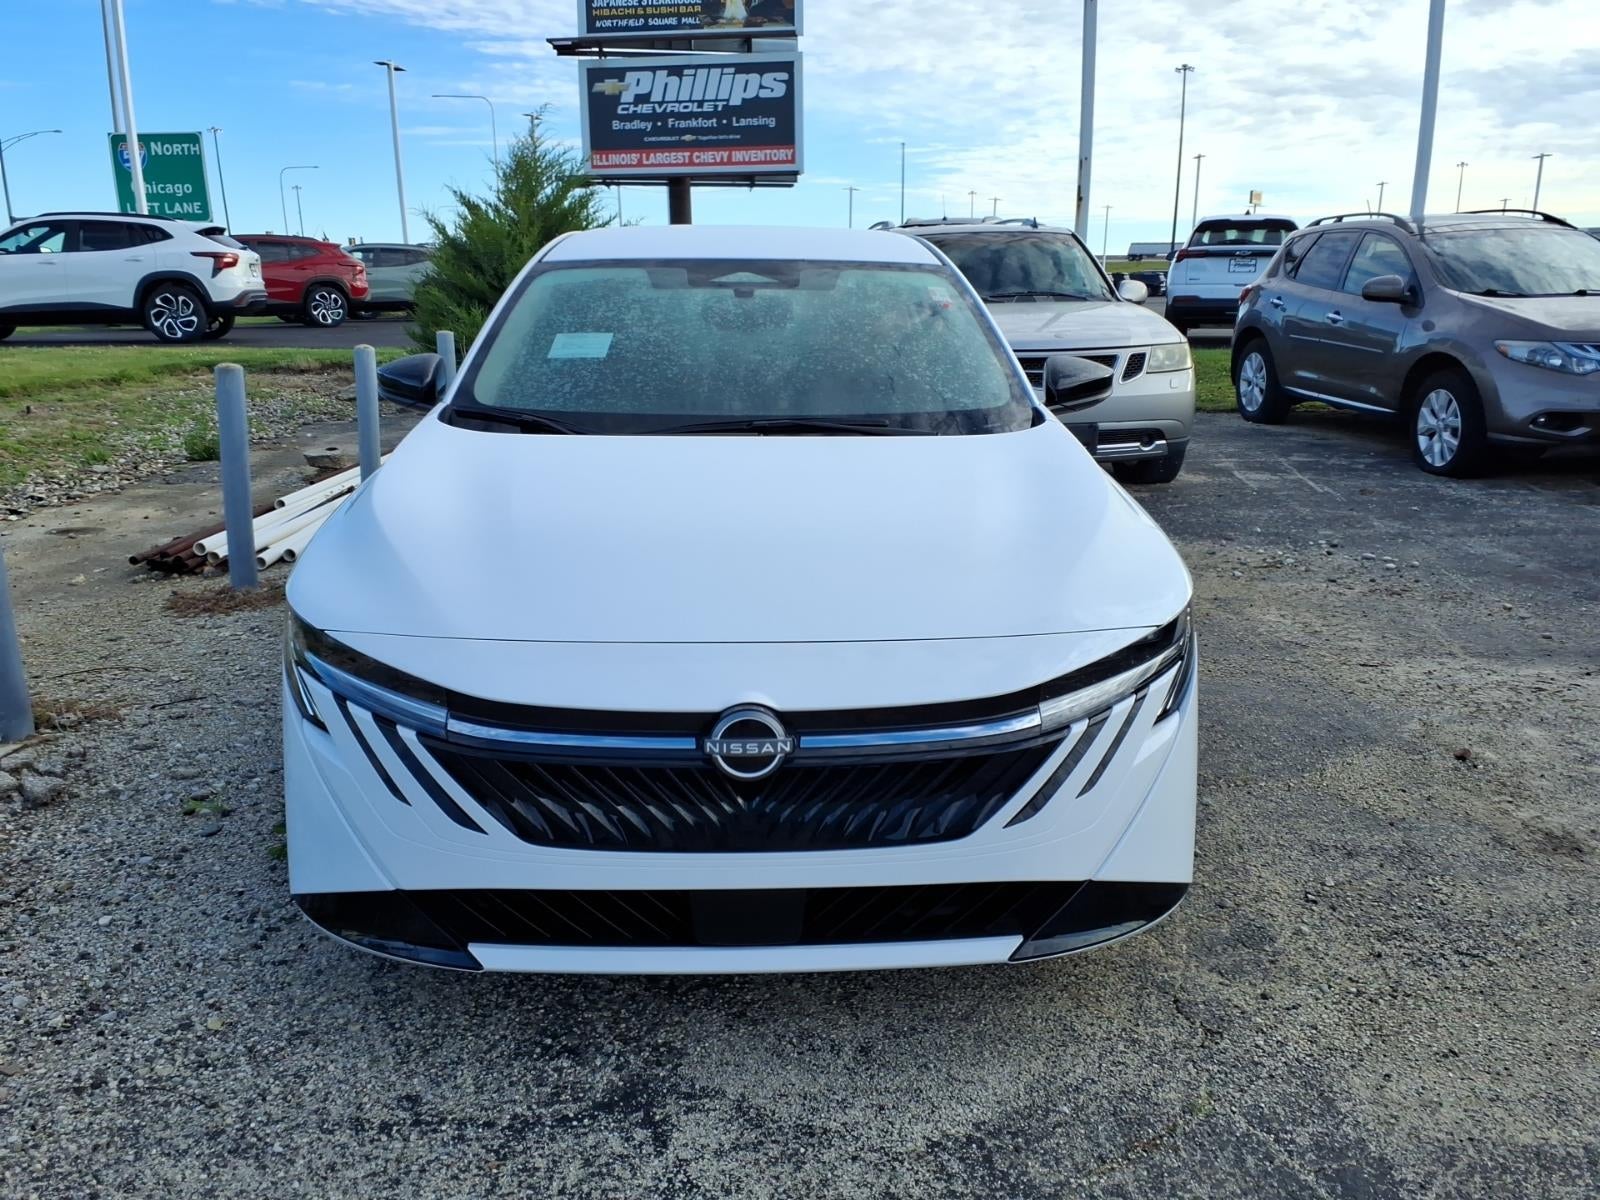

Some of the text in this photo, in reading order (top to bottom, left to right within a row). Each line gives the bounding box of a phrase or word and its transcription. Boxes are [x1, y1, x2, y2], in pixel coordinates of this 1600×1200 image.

[592, 8, 635, 16] HIBACHI
[646, 6, 678, 14] SUSHI
[679, 5, 702, 13] BAR
[596, 16, 701, 27] NORTHFIELD SQUARE MALL
[620, 68, 789, 105] Phillips
[617, 102, 727, 114] CHEVROLET
[612, 116, 776, 131] Bradley Frankfort Lansing
[150, 141, 200, 156] NORTH
[593, 148, 793, 166] ILLINOIS' LARGEST CHEVY INVENTORY
[131, 181, 193, 197] hicago
[126, 202, 203, 214] LFT LANE
[706, 742, 791, 754] NISSAN
